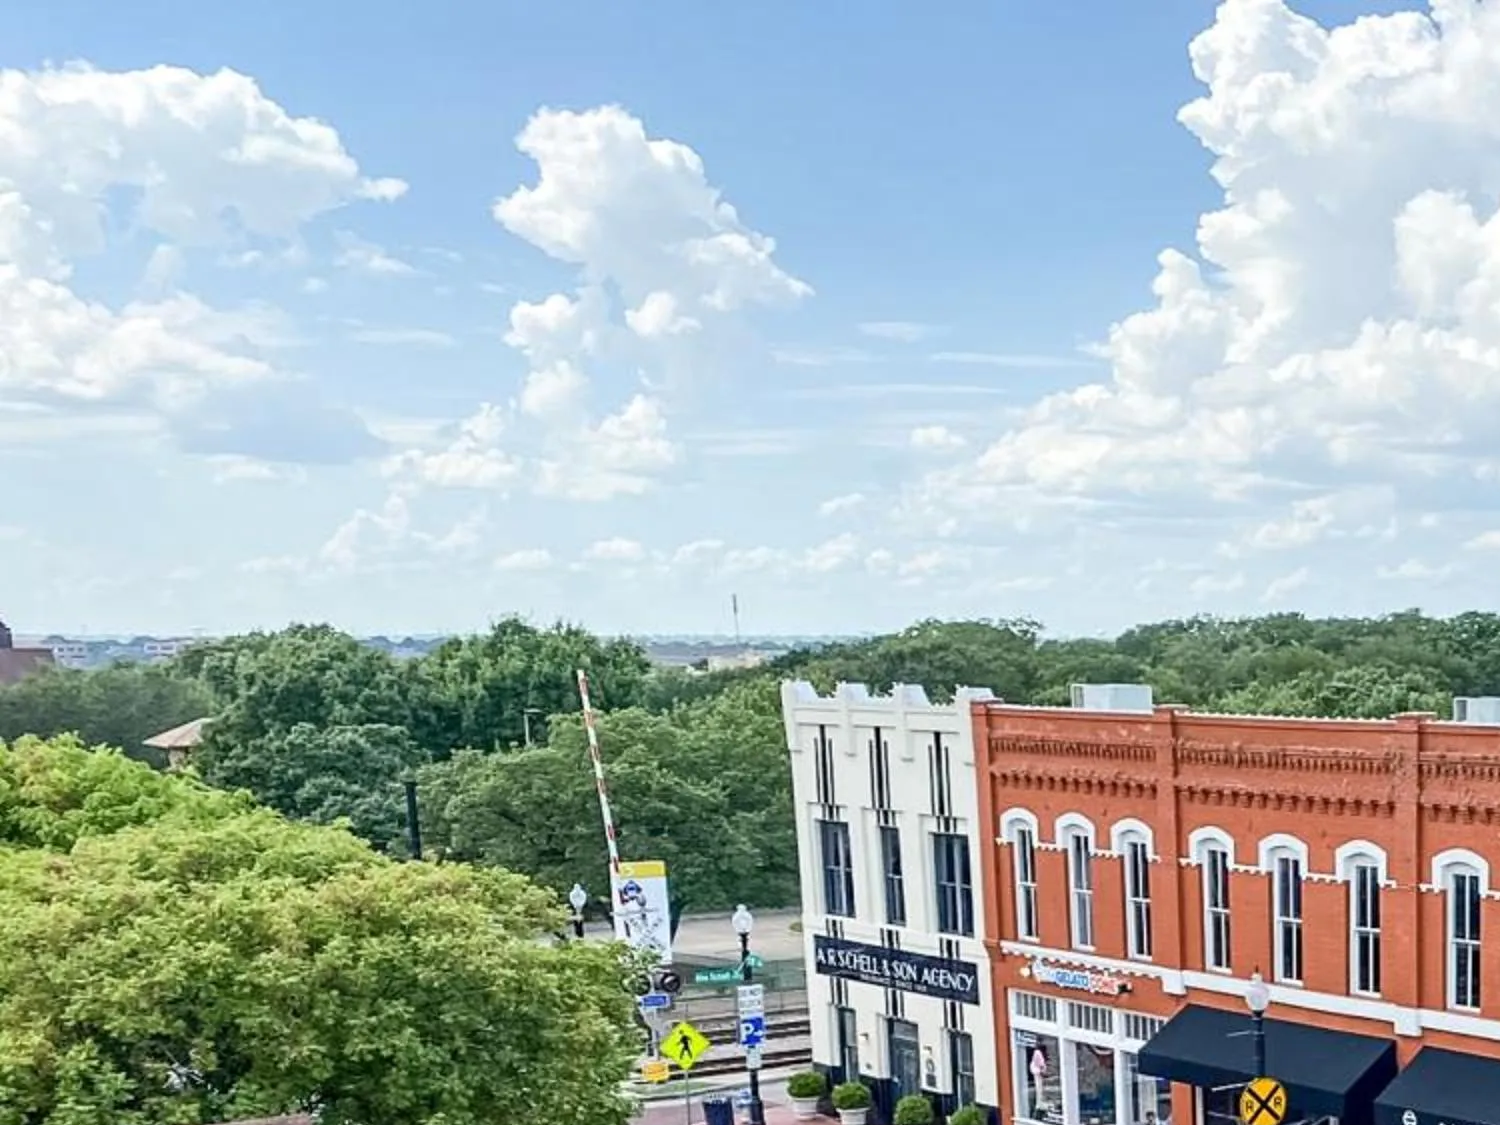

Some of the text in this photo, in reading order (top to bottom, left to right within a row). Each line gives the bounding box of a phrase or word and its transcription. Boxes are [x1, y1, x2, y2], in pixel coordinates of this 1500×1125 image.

[837, 950, 880, 976] SCHELL
[892, 960, 918, 982] SON
[920, 967, 974, 993] AGENCY
